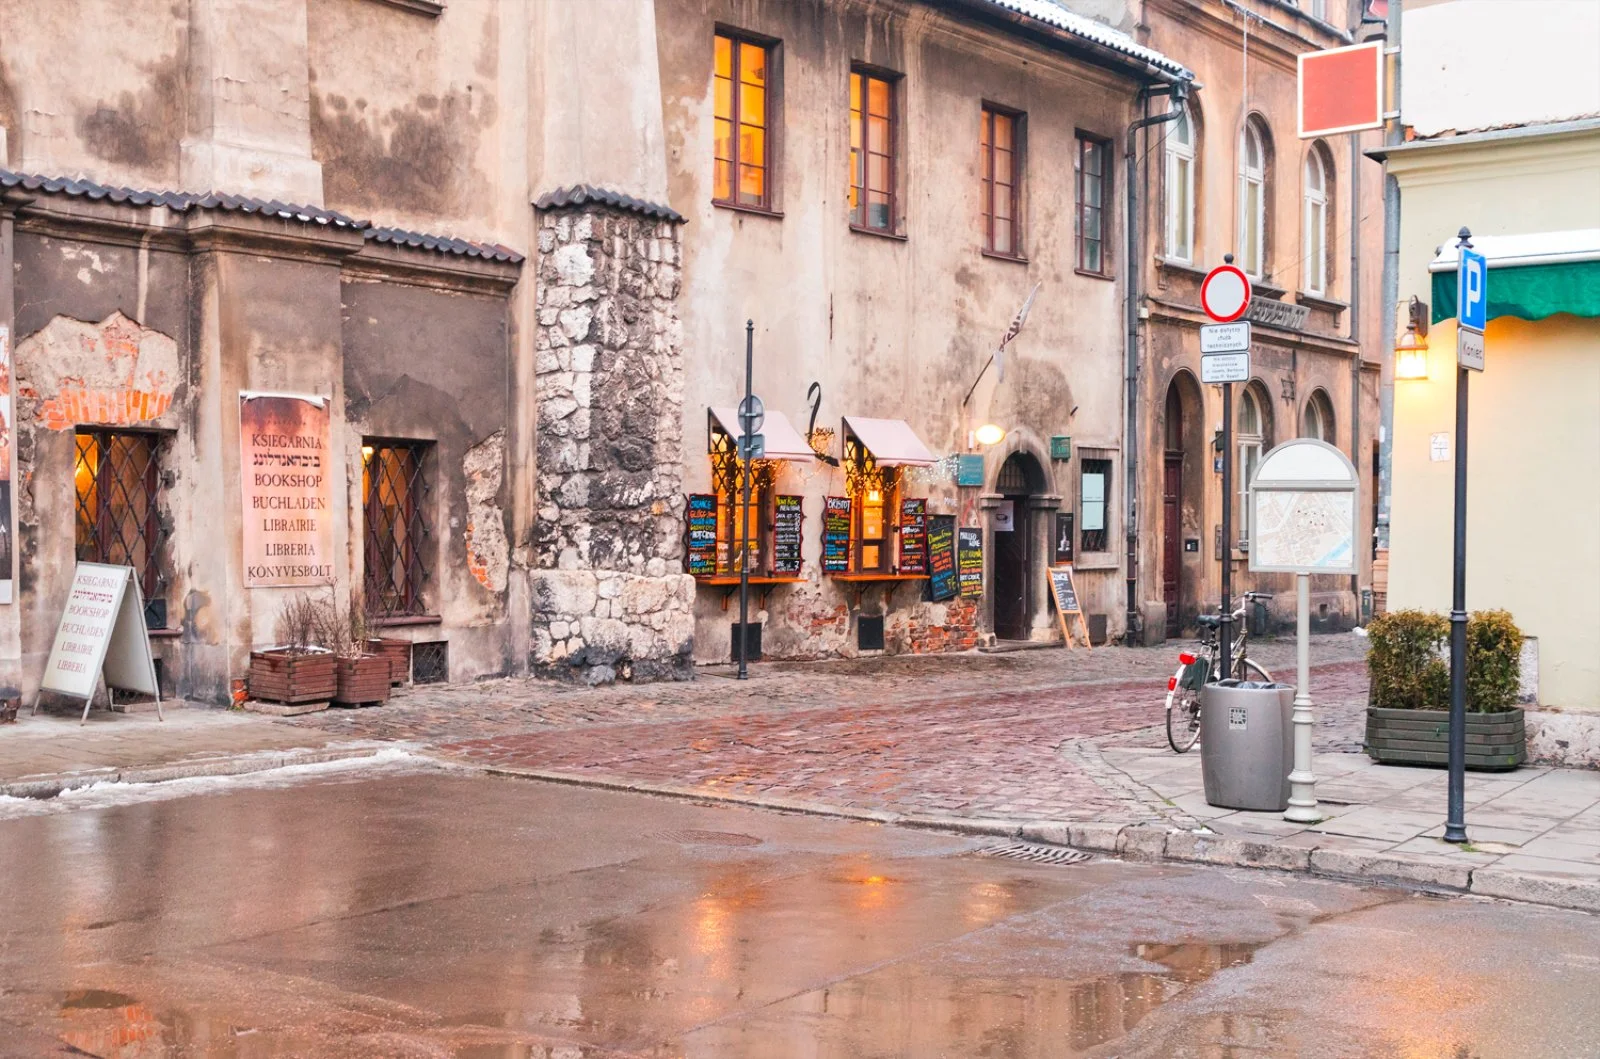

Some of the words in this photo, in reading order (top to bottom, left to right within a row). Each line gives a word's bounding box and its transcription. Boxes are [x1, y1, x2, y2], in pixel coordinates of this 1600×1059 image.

[1466, 258, 1481, 318] P
[255, 473, 322, 488] BOOKSHOP
[253, 496, 326, 510] BUCHLADEN
[263, 518, 317, 532] LIBRAIRIE
[265, 543, 316, 557] LIBRERIA
[68, 604, 110, 618] BOOKSHOP
[61, 621, 106, 638] BUCHLADEN
[61, 640, 94, 656] LIBRAIRIE
[57, 659, 87, 674] LIBRERIA
